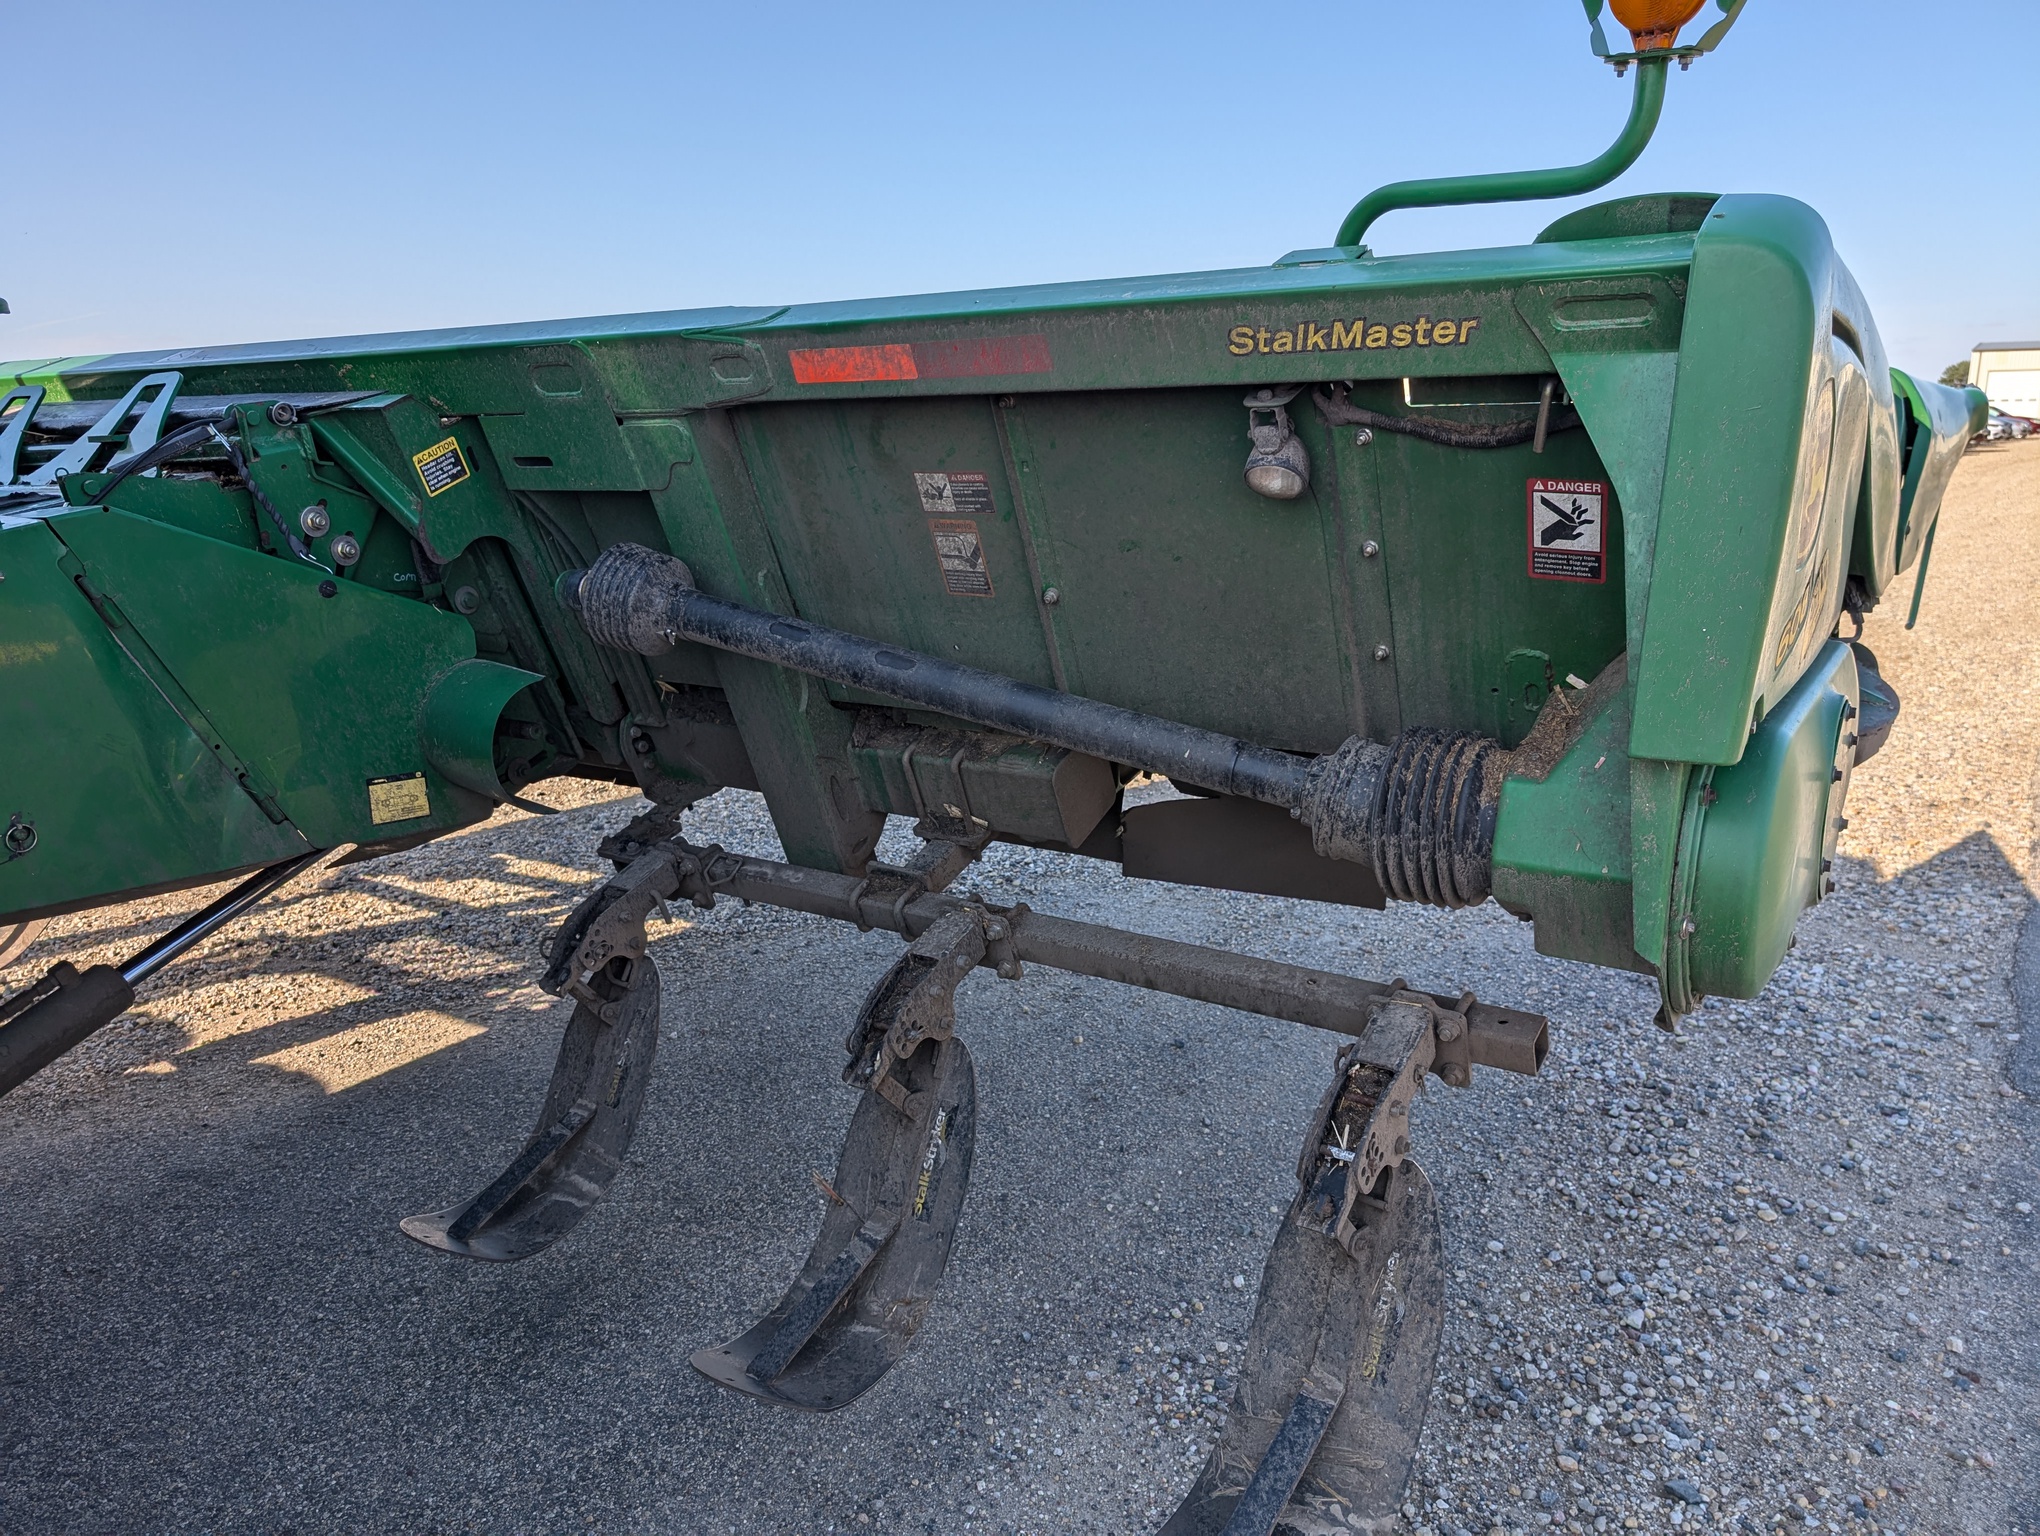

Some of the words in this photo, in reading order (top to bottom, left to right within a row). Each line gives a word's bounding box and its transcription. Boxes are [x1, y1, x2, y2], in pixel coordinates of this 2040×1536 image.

[1228, 315, 1479, 355] StalkMaster
[421, 439, 455, 461] CAUTION
[1548, 481, 1601, 492] DANGER
[393, 573, 417, 582] Corn
